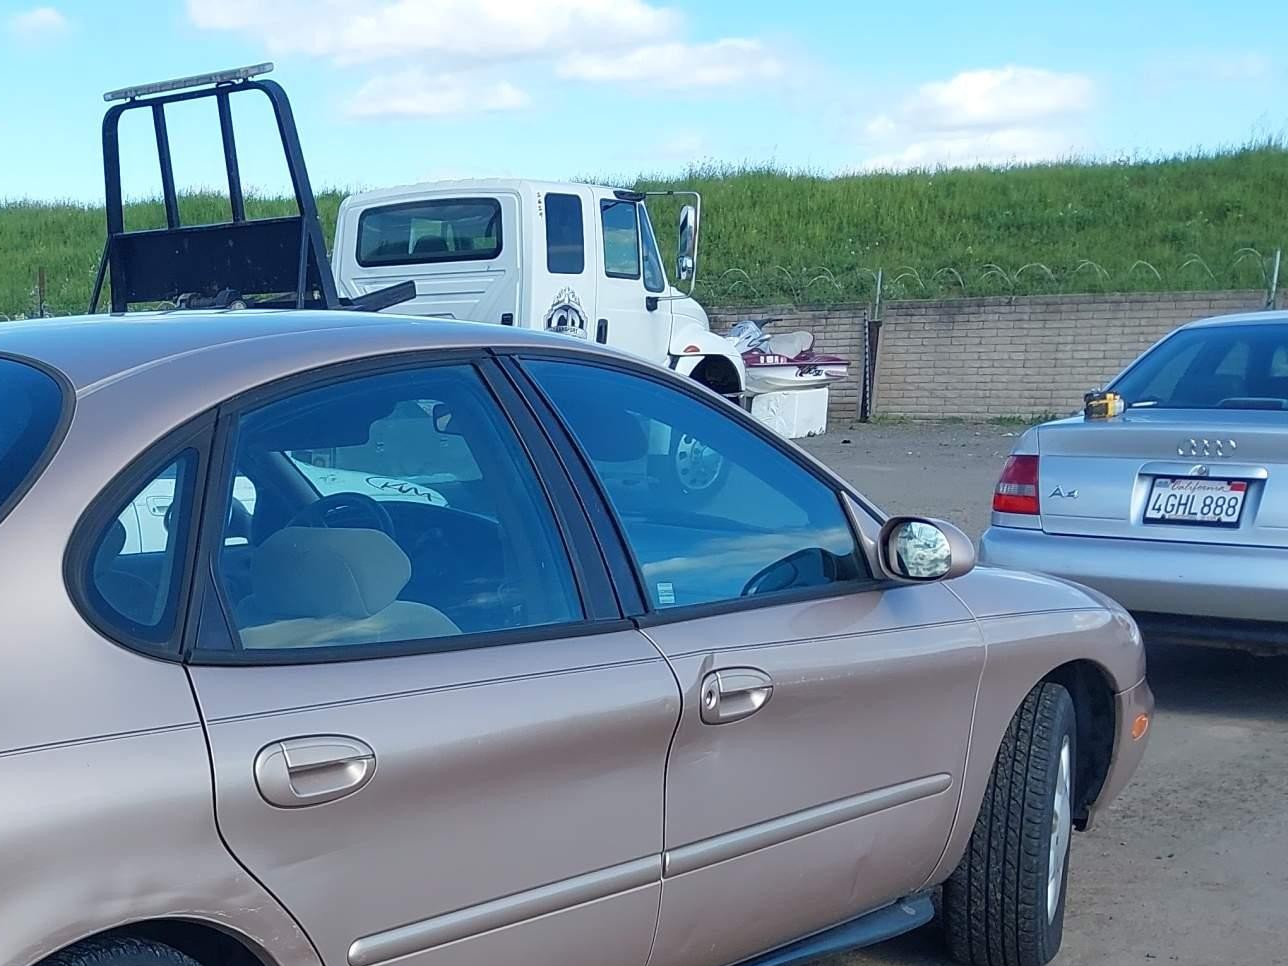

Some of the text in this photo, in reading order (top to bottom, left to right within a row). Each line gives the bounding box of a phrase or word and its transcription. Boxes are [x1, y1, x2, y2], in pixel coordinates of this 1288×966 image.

[1048, 485, 1079, 499] A4
[1171, 481, 1226, 494] California
[1152, 493, 1239, 517] 4GHL888
